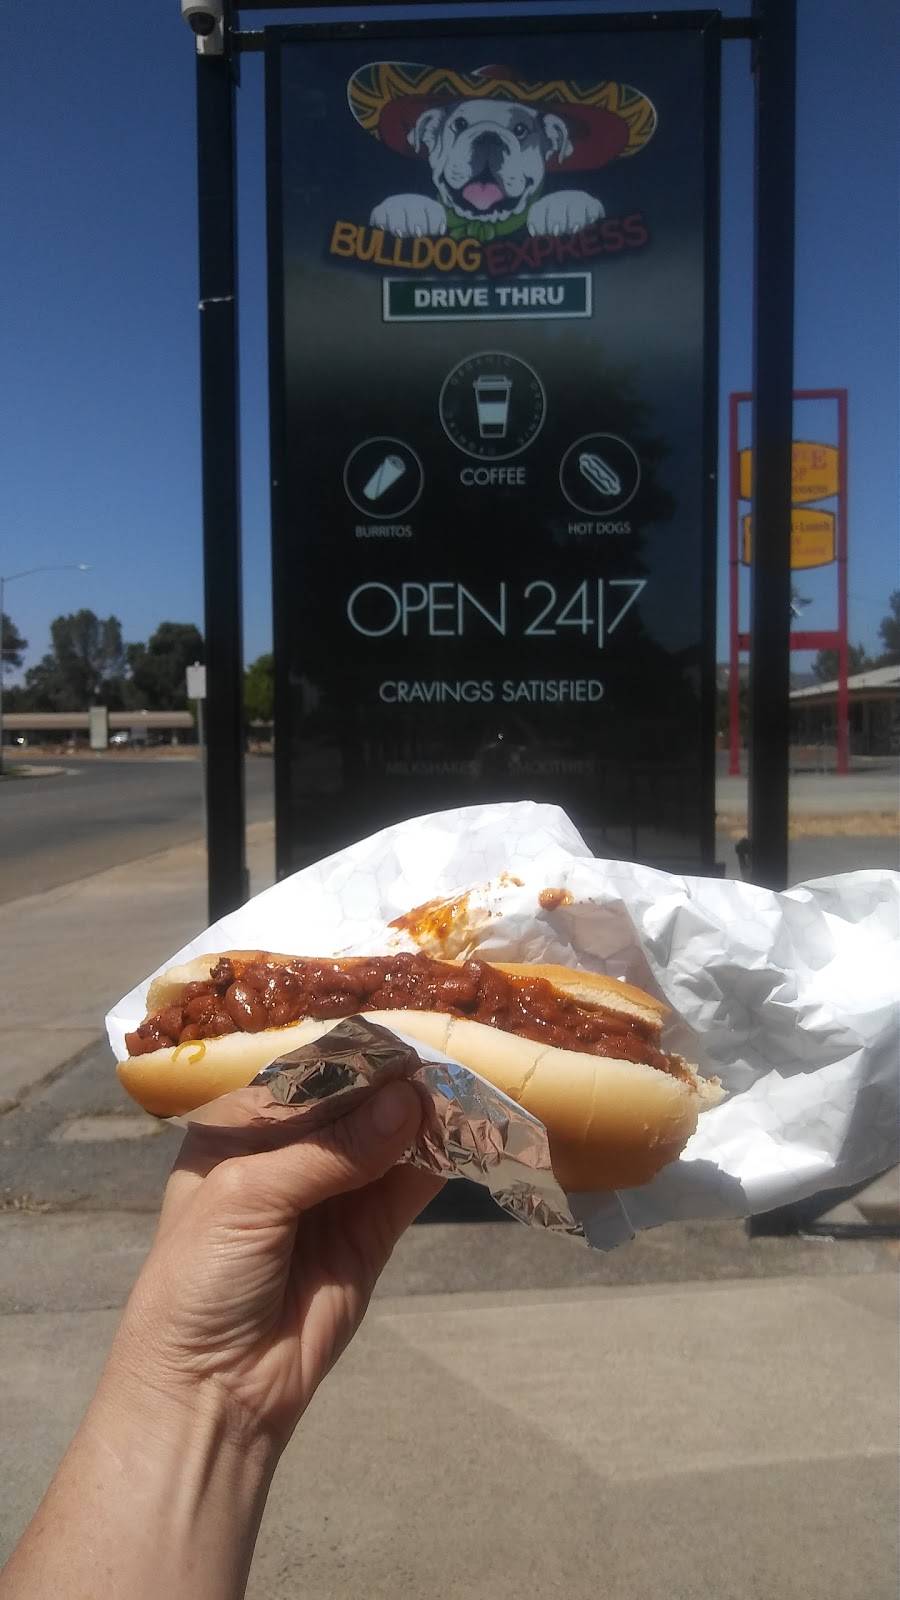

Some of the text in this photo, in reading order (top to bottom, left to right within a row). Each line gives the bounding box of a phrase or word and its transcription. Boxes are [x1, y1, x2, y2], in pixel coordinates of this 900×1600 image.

[330, 214, 648, 275] BULLDOG EXPRESS
[414, 286, 565, 308] DRIVE THRU
[459, 467, 526, 486] COFFEE
[355, 525, 412, 538] BURRITOS
[568, 522, 632, 535] HOT DOGS
[347, 581, 506, 637] OPEN
[379, 680, 605, 702] CRAVINGS SATISFIED
